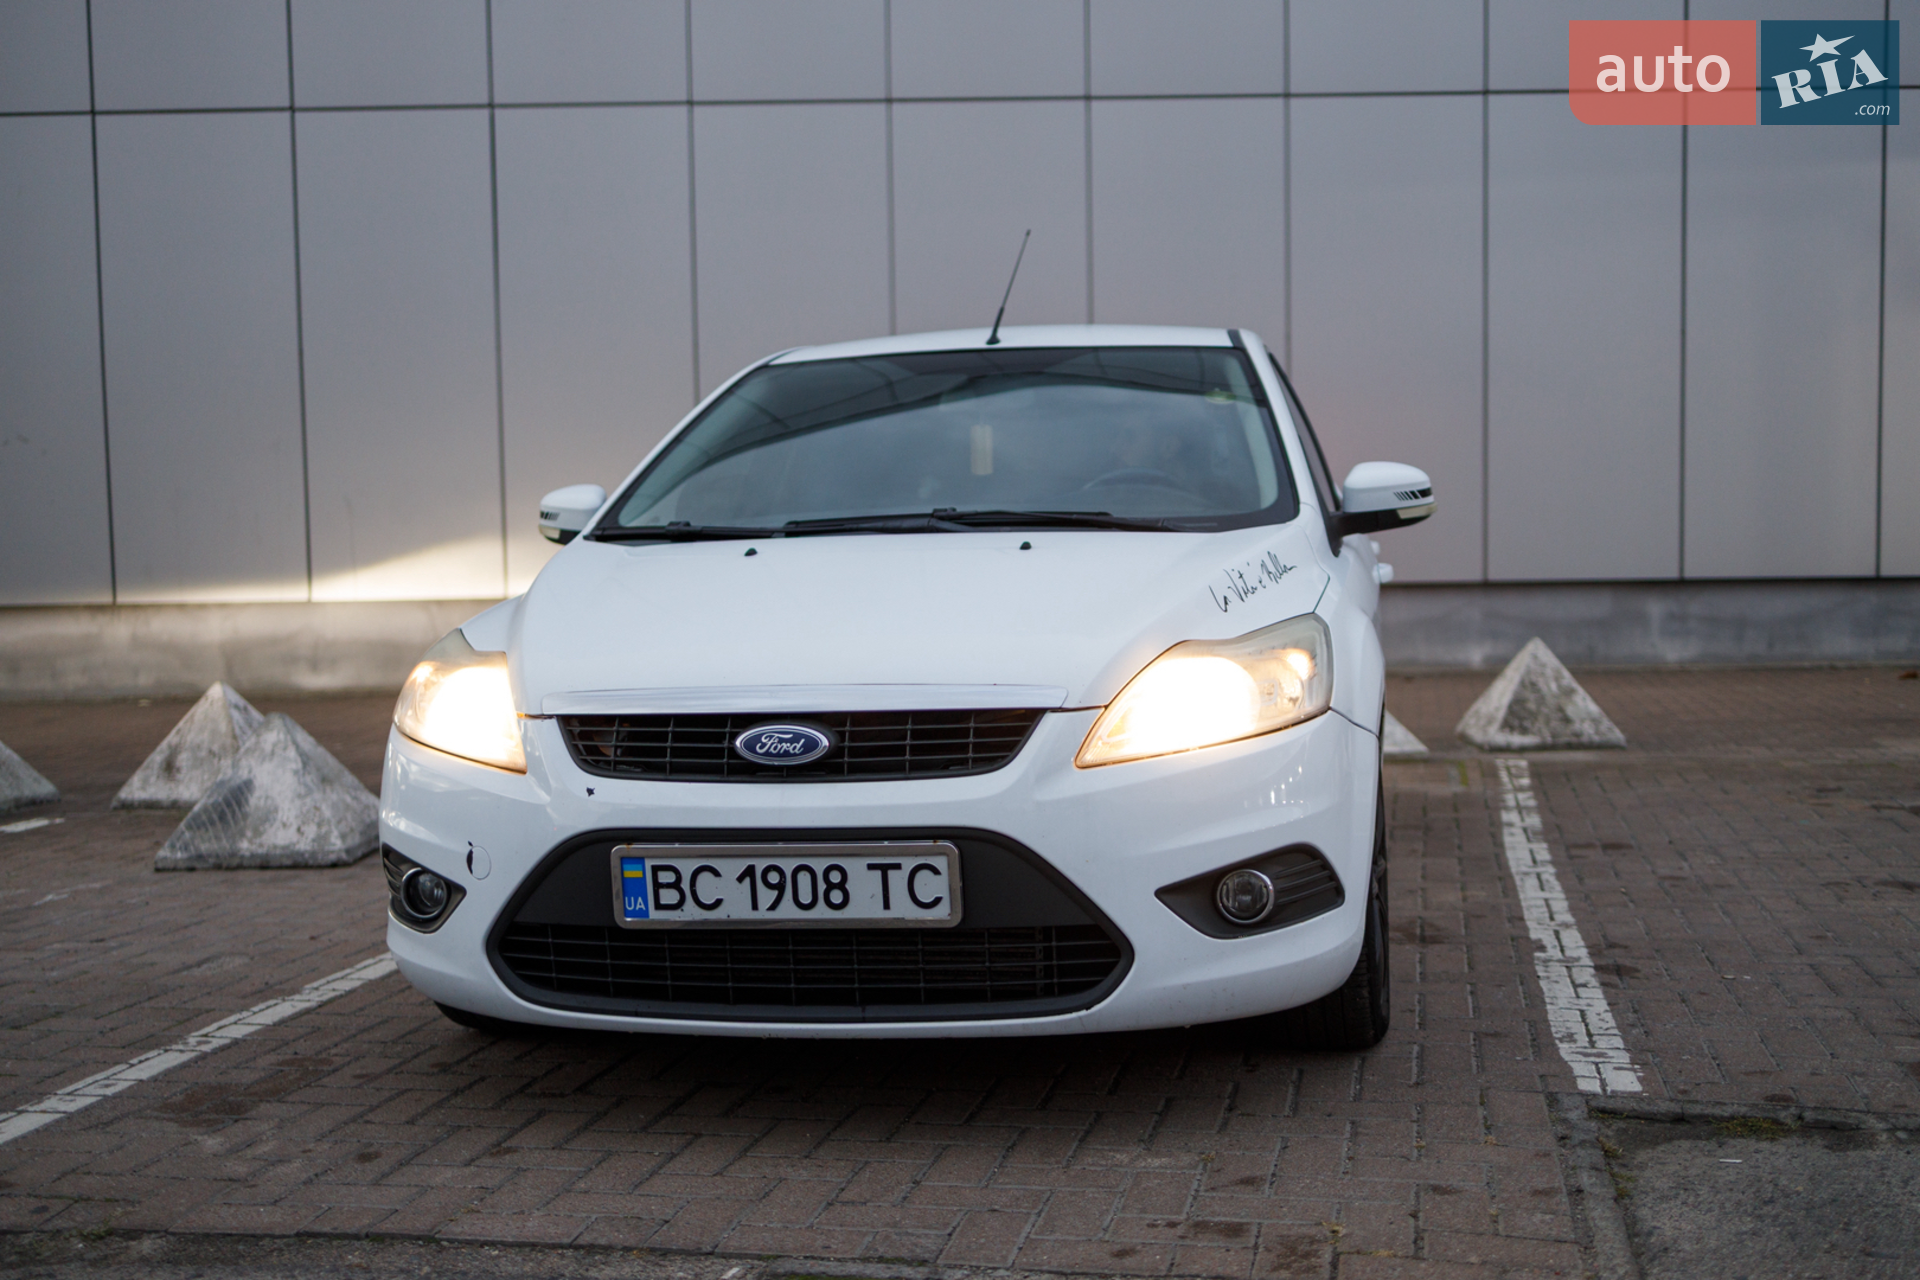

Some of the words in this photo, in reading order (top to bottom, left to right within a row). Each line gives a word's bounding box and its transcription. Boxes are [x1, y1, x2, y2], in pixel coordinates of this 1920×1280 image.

[756, 733, 805, 754] Ford
[651, 863, 724, 912] BC
[735, 863, 850, 912] 1908
[866, 862, 944, 911] TC
[625, 897, 646, 911] UA
